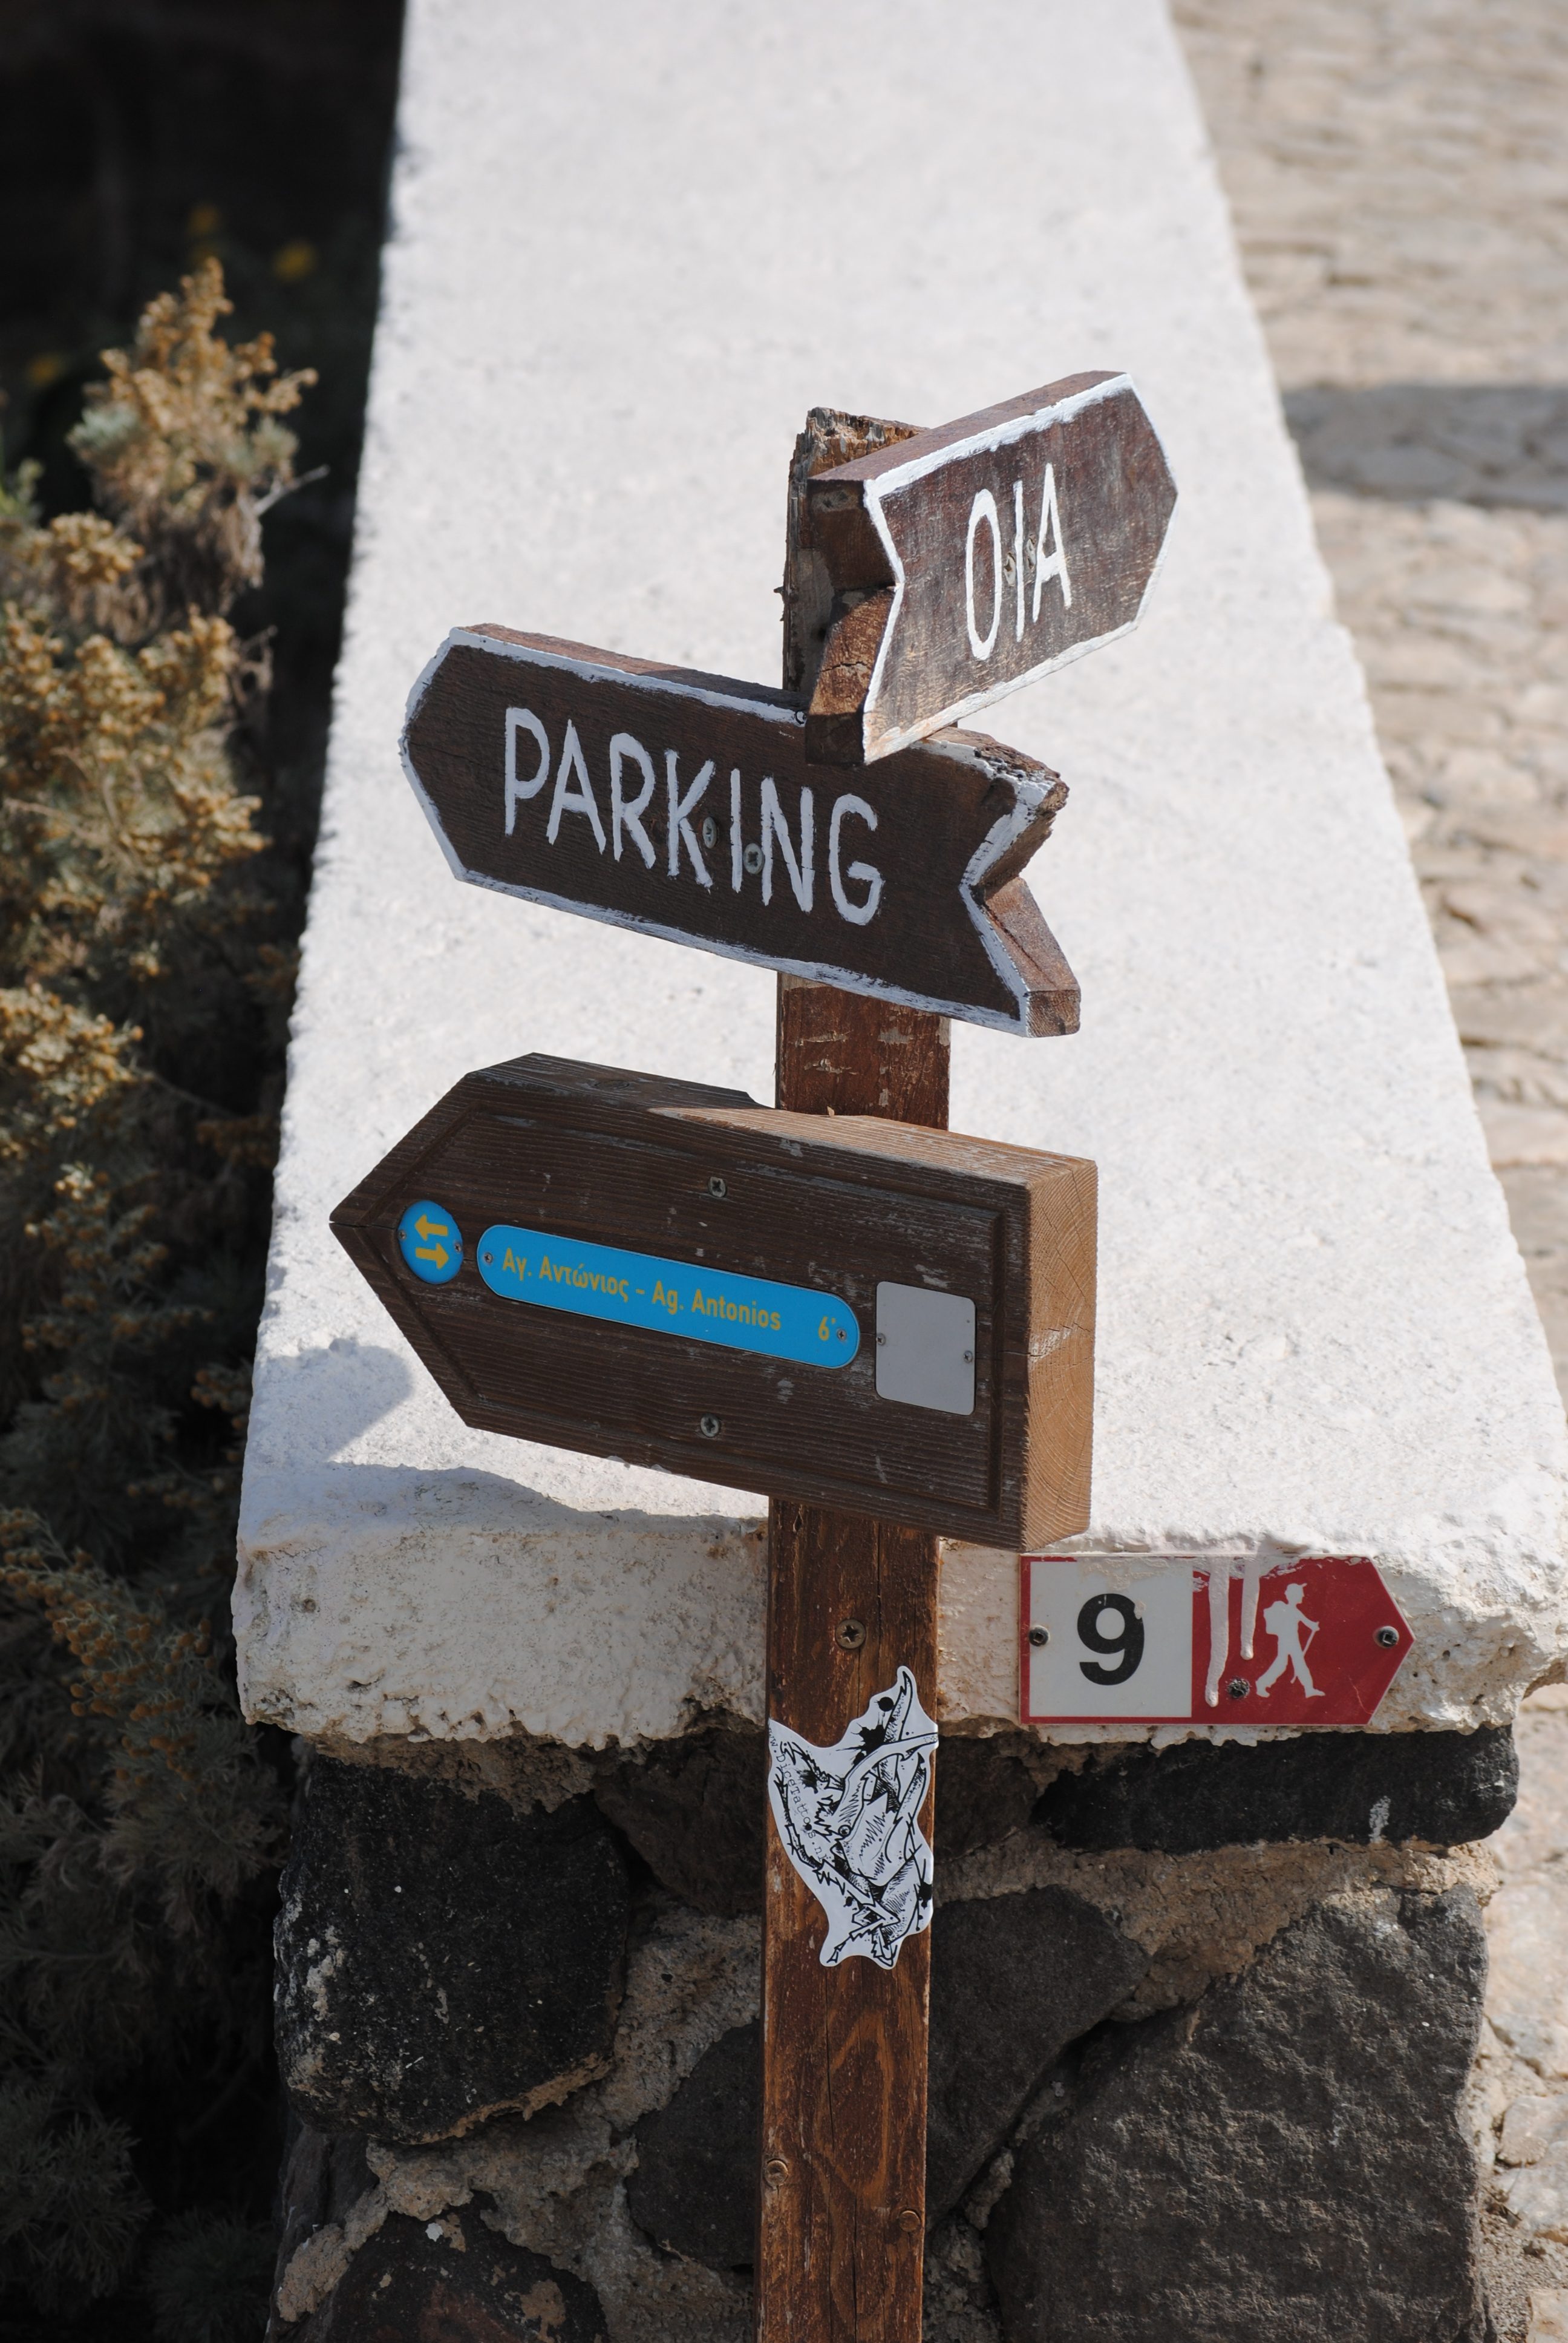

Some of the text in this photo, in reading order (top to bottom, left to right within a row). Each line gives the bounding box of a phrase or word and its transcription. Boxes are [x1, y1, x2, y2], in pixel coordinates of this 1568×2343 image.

[965, 463, 1072, 661] OIA
[505, 707, 885, 925] PARKING
[503, 1247, 532, 1280] Αγ.
[538, 1256, 629, 1303] Αντώνιος
[652, 1280, 685, 1315] Ag.
[691, 1288, 782, 1331] Antonios
[1077, 1593, 1145, 1686] 9
[768, 1728, 828, 1863] ww.DiceTattos.nl
